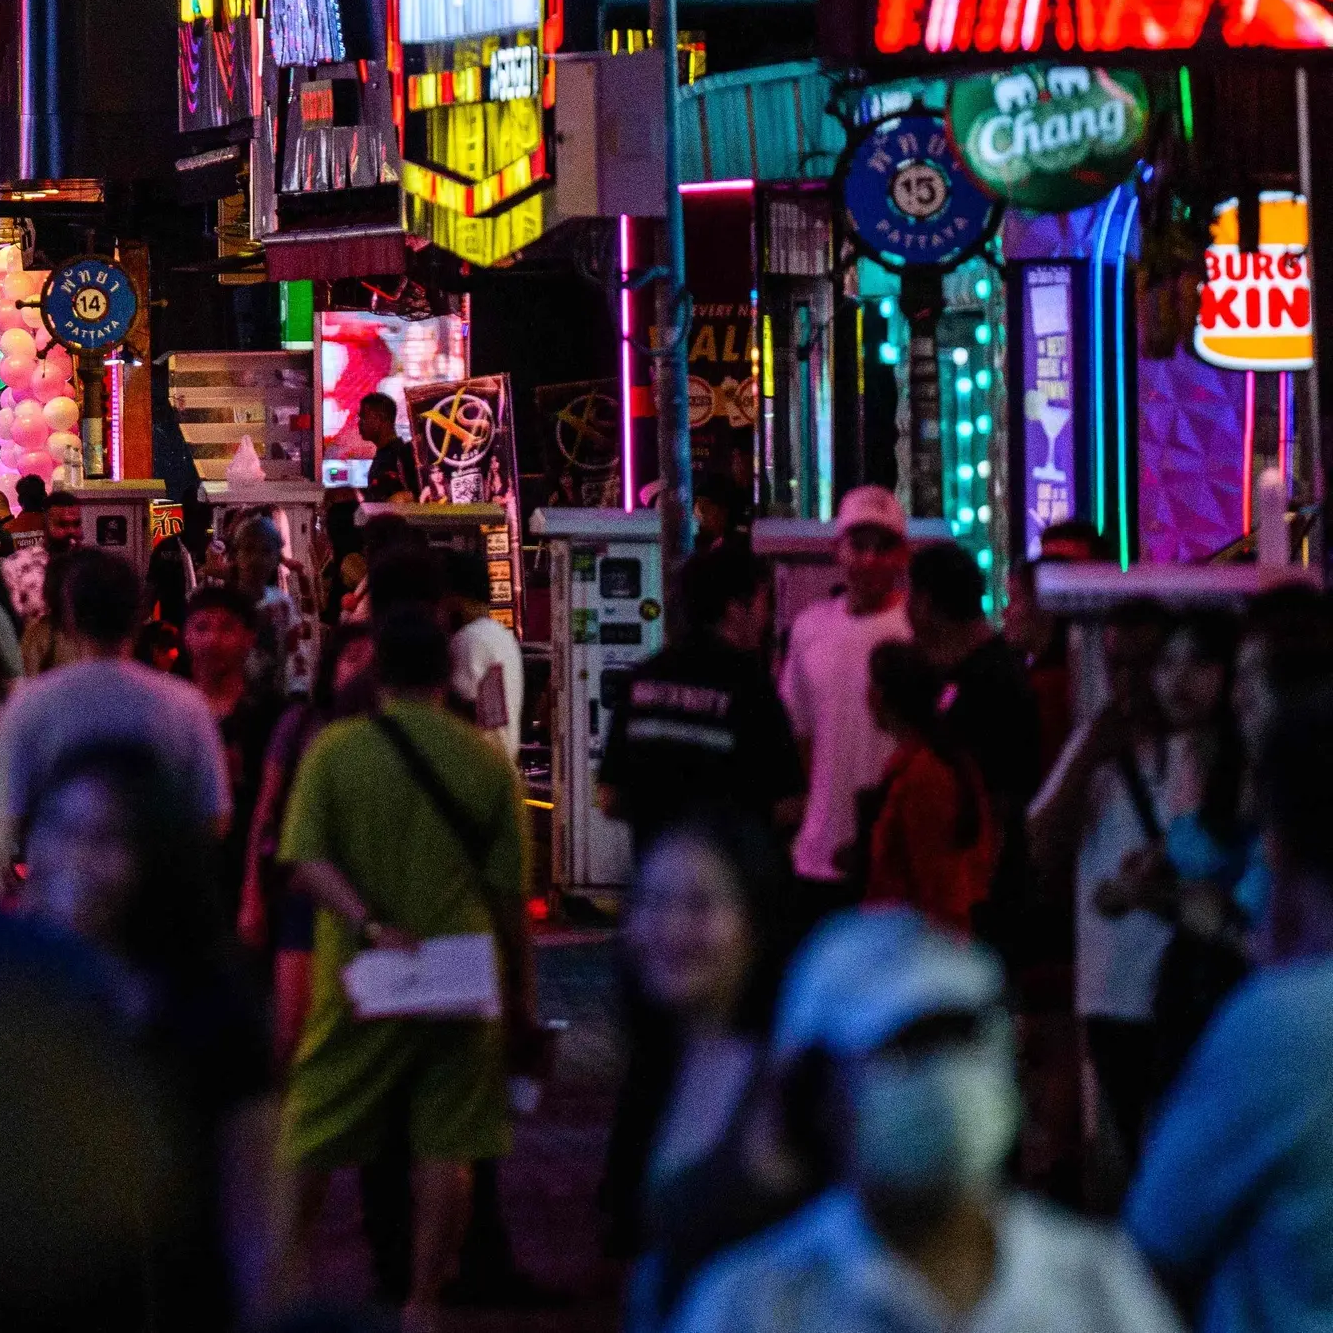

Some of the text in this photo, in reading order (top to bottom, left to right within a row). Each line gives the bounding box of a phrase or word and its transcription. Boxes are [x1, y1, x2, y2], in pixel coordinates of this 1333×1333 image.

[978, 100, 1125, 165] Chang
[903, 176, 937, 205] 15
[81, 295, 101, 312] 14
[64, 320, 120, 339] PATTAYA
